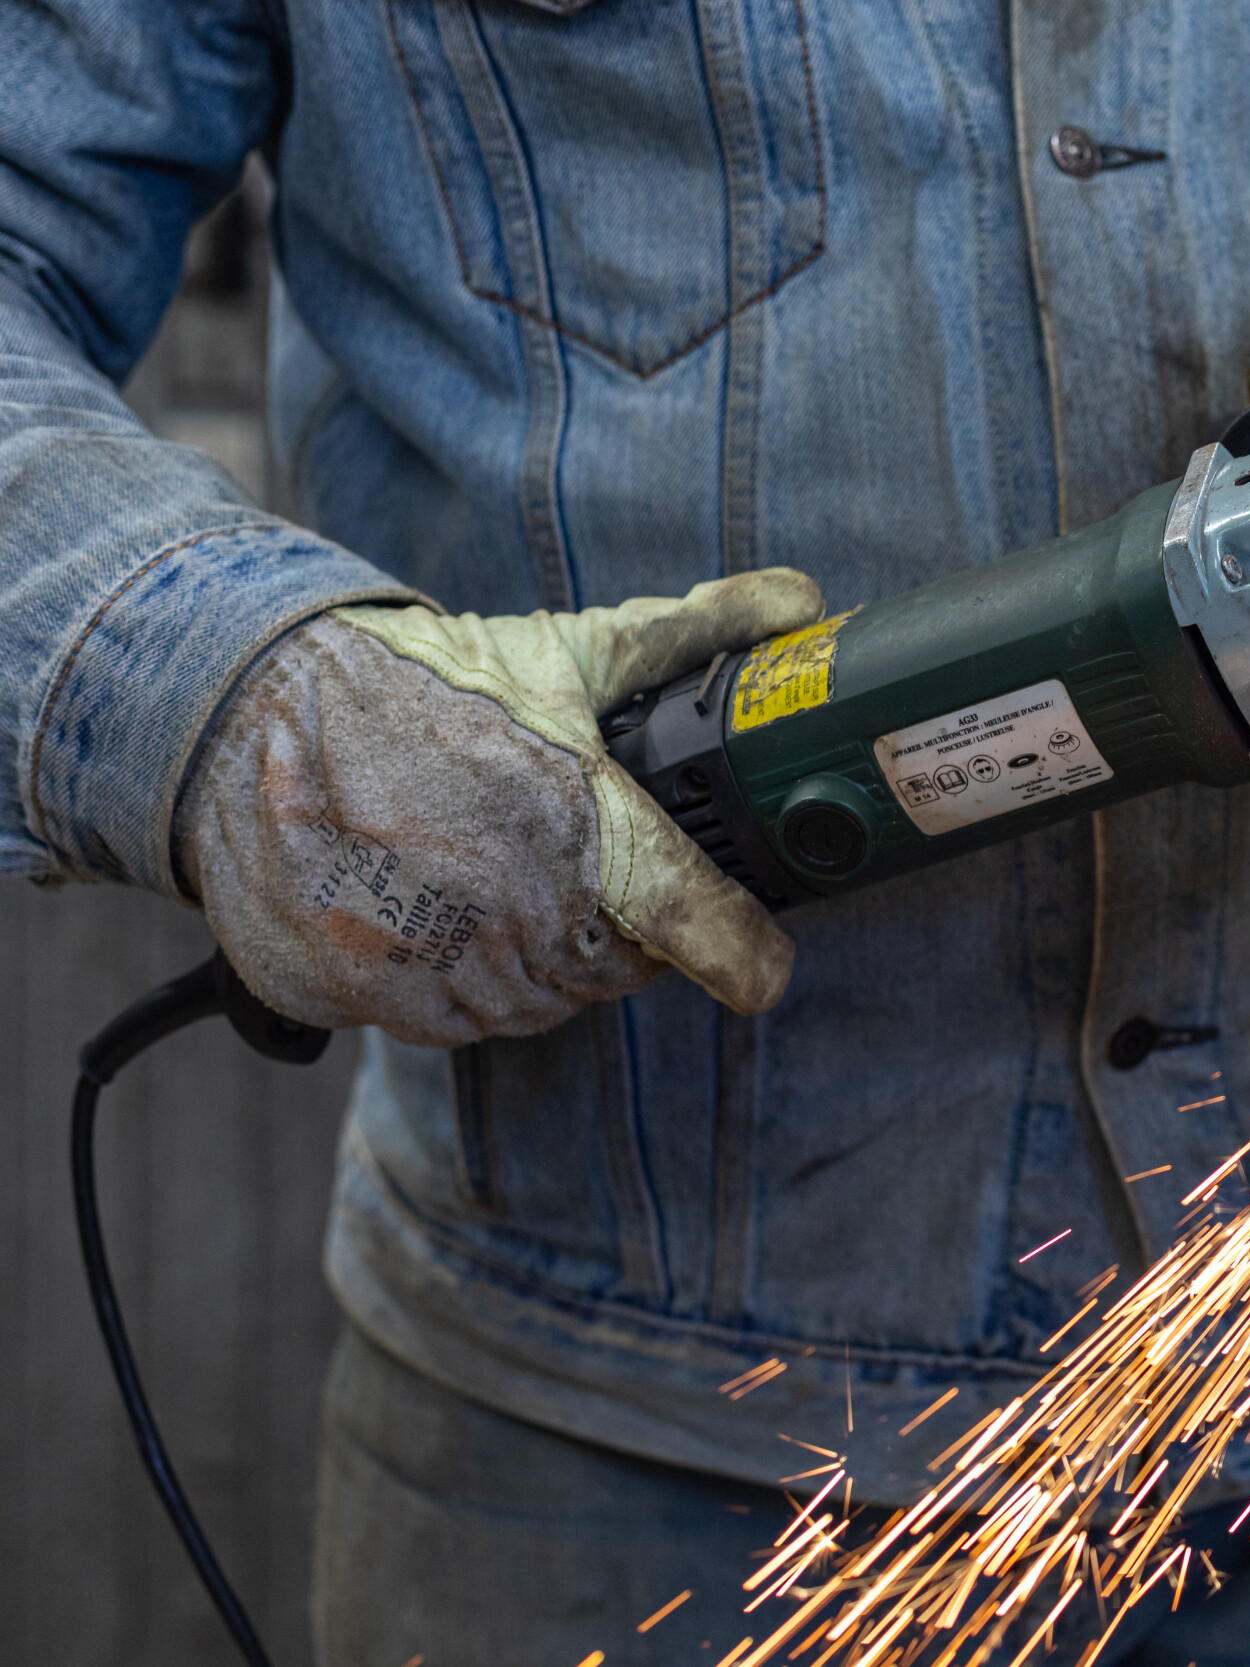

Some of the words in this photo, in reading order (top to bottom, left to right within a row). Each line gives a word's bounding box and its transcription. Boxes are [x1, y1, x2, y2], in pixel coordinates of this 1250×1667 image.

[891, 743, 923, 760] APPAREIL
[924, 724, 980, 749] MULTIFONCTION
[984, 711, 1020, 728] MEULEUSE
[1021, 701, 1051, 716] D'ANGLE
[959, 713, 979, 727] AG33
[937, 738, 973, 755] PONCEUSE
[976, 725, 1015, 743] LUSTREUSE
[383, 853, 401, 875] EN
[401, 884, 443, 938] Taille
[430, 903, 487, 975] LEBON
[387, 946, 412, 964] 10
